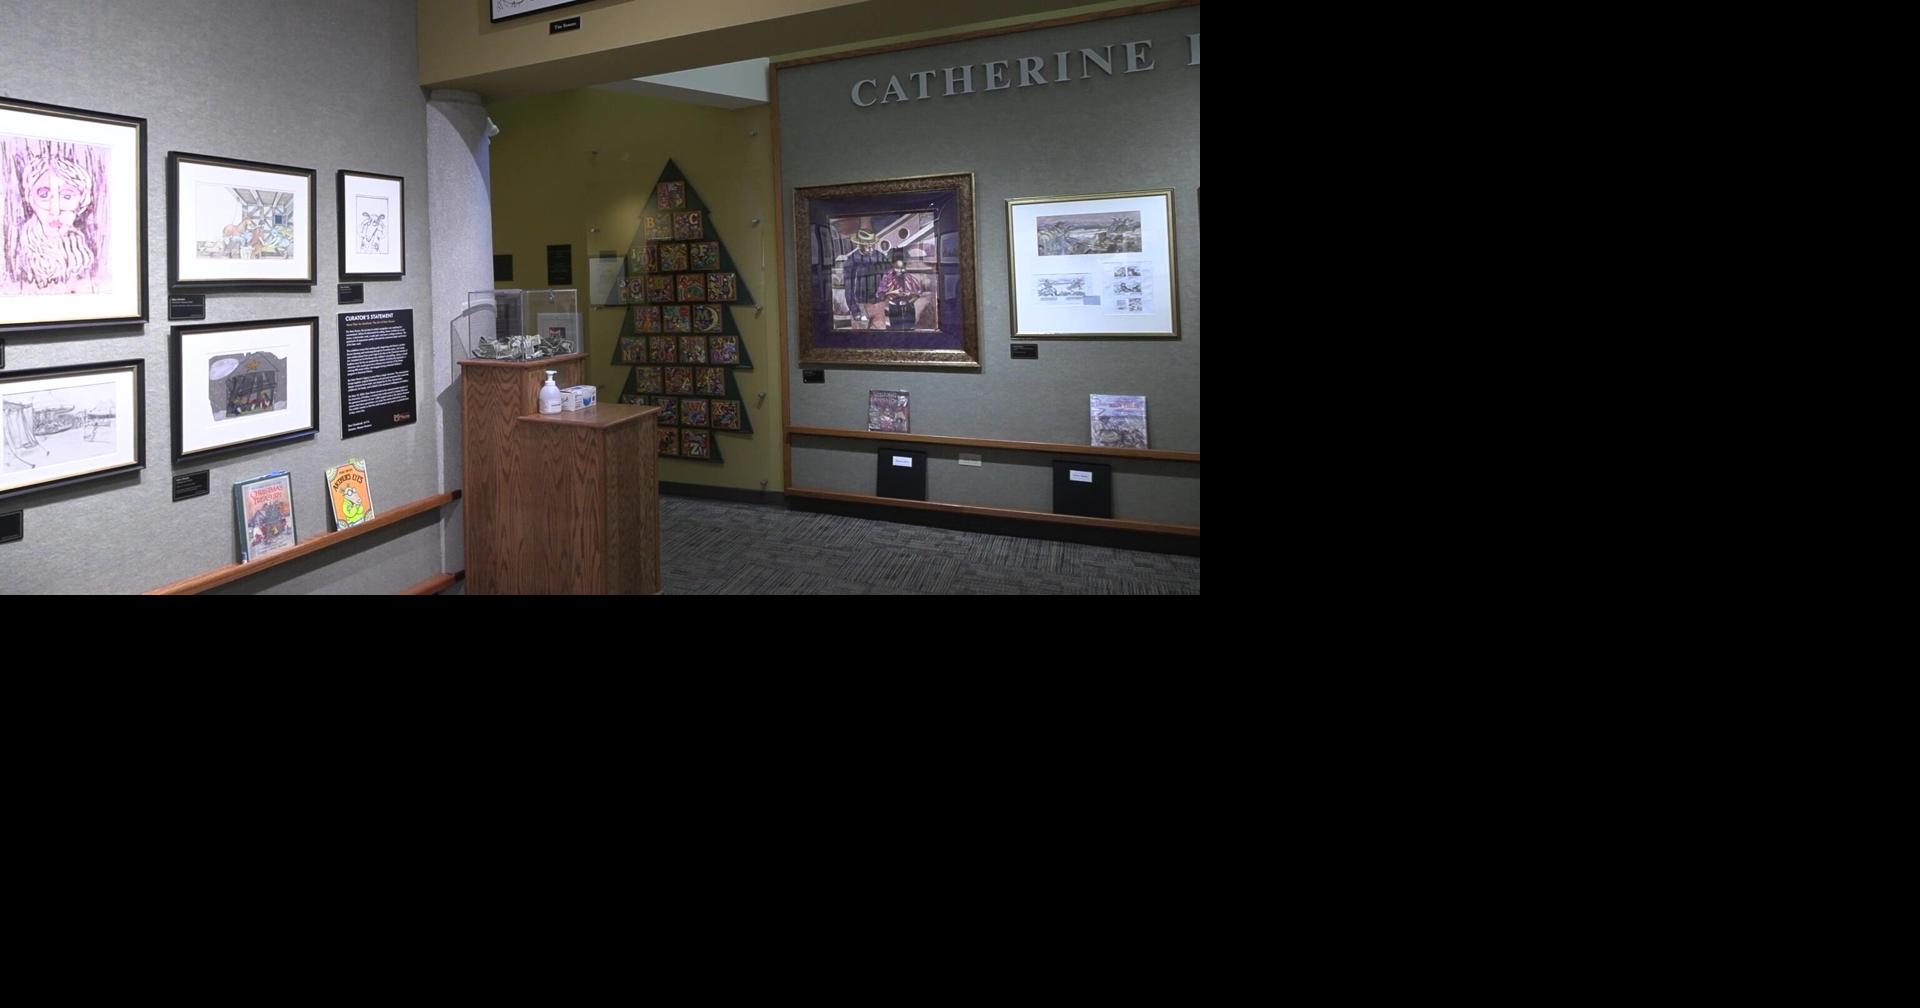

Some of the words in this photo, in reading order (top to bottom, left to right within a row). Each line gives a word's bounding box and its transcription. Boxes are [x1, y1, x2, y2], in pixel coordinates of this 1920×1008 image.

[851, 39, 1155, 107] CATHERINE
[646, 216, 655, 228] B
[688, 212, 699, 225] C
[344, 313, 370, 322] CURATOR'S
[370, 312, 394, 320] STATEMENT
[689, 442, 700, 455] Z
